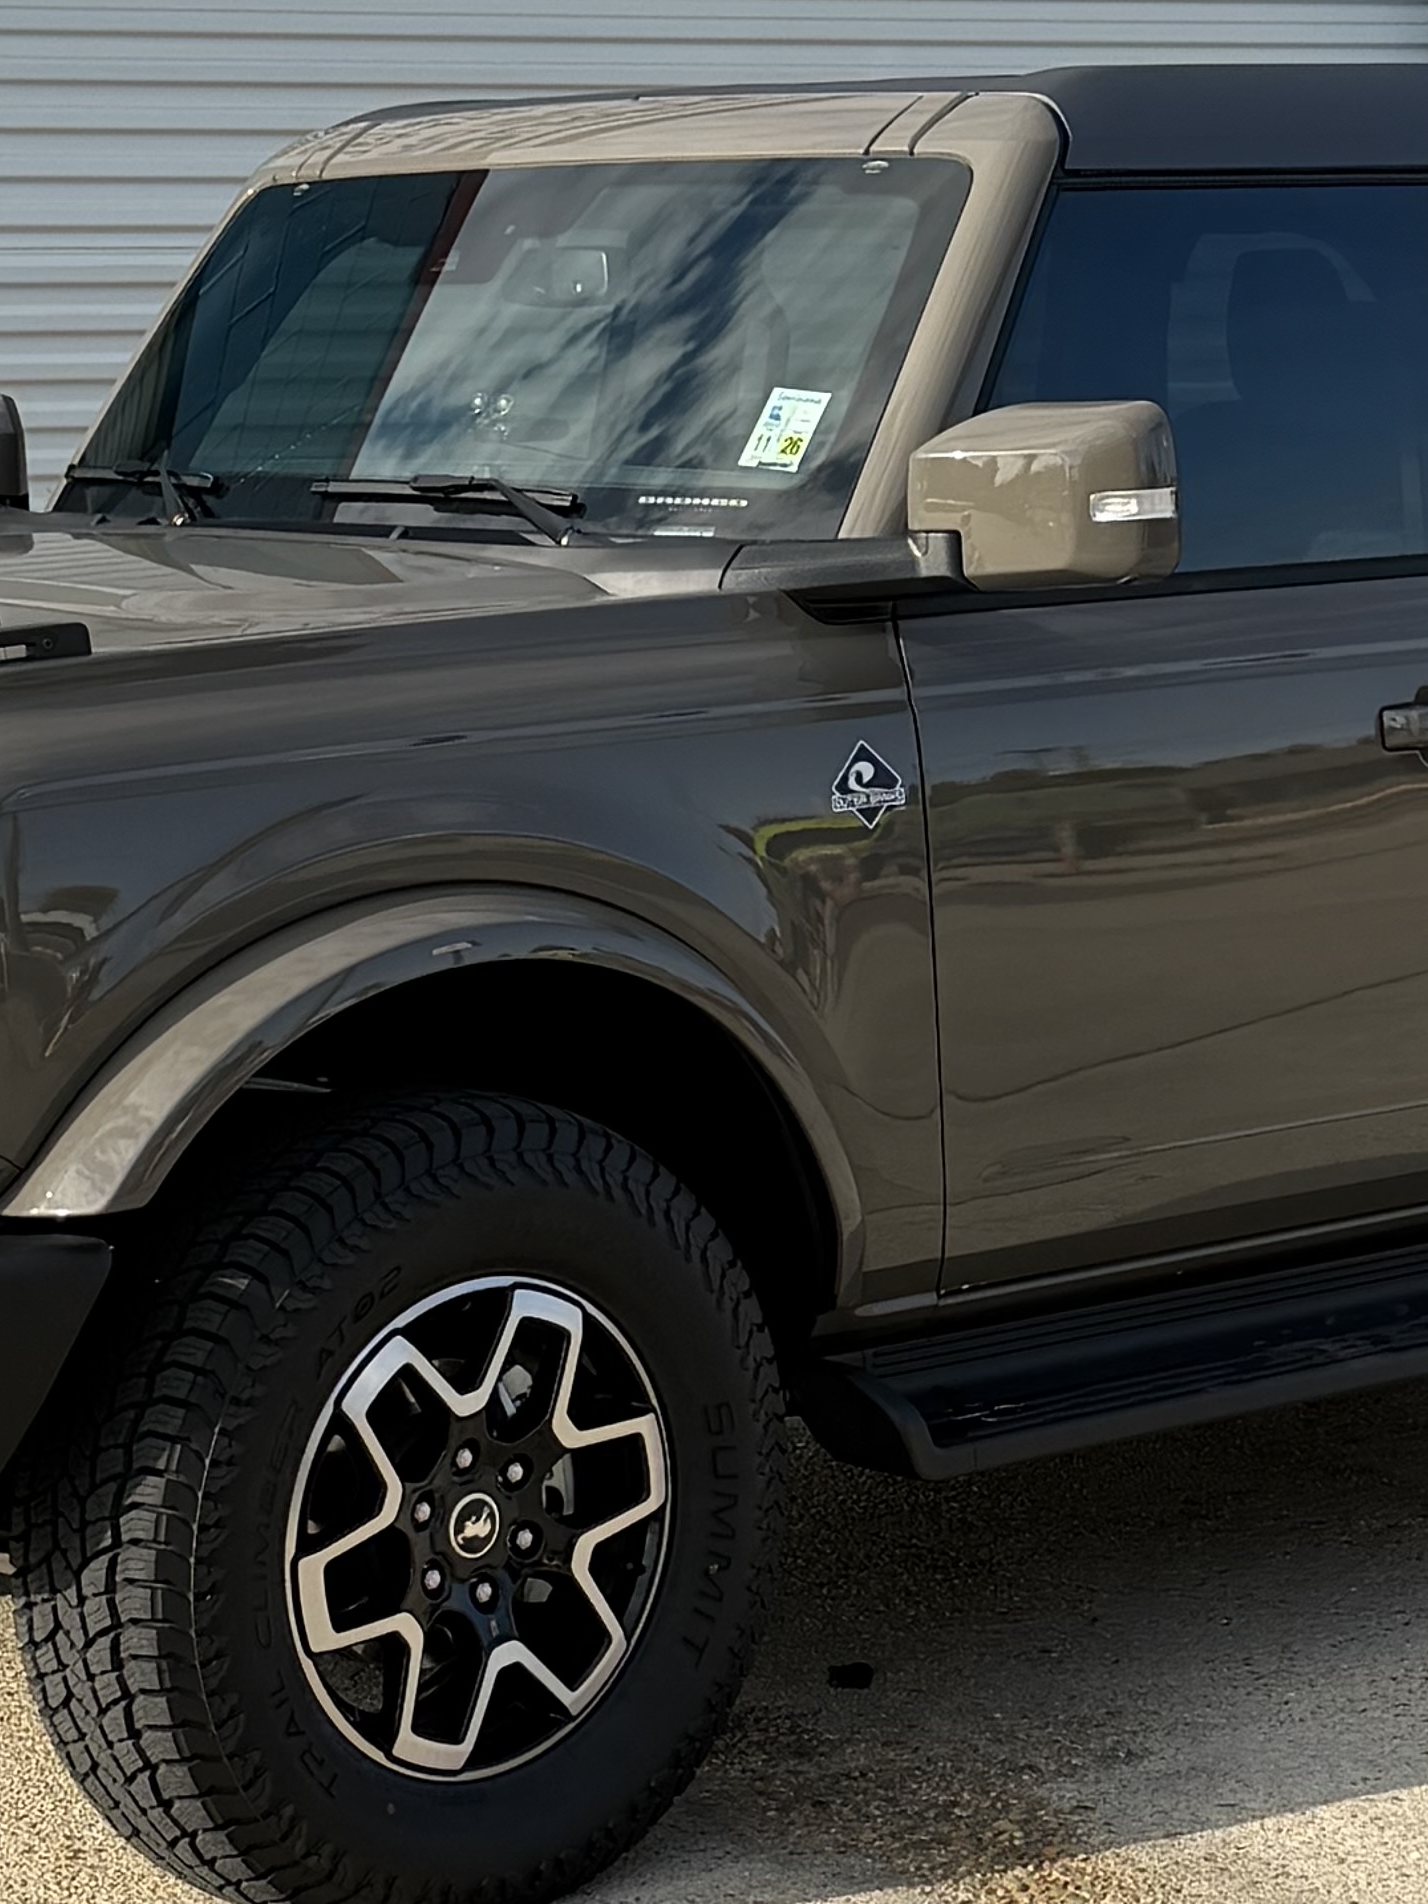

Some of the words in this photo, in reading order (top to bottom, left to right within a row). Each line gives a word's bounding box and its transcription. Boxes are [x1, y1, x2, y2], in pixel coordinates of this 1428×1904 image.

[779, 436, 803, 456] 26
[683, 1401, 739, 1668] SUMMIT
[272, 1668, 338, 1798] TRAIL
